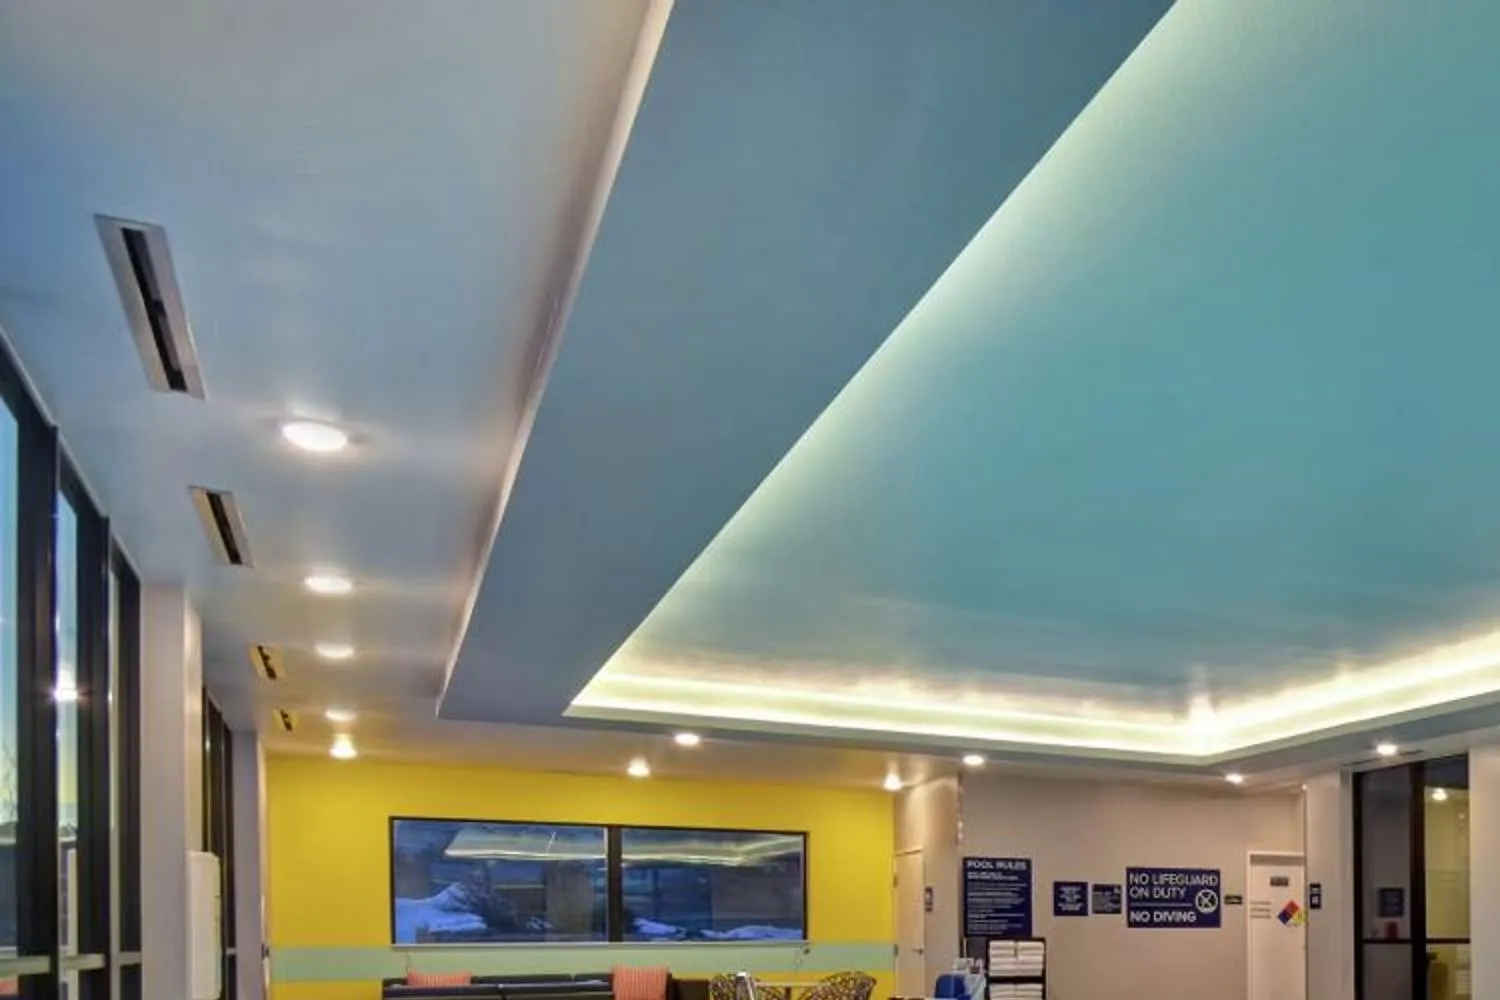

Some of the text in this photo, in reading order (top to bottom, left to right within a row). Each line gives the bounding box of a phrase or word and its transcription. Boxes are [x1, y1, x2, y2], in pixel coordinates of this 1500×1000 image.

[967, 860, 994, 870] POOL
[1129, 872, 1218, 887] NO LIFEGUARD
[1129, 886, 1186, 899] ON DUTY
[1130, 911, 1197, 922] NO DIVING
